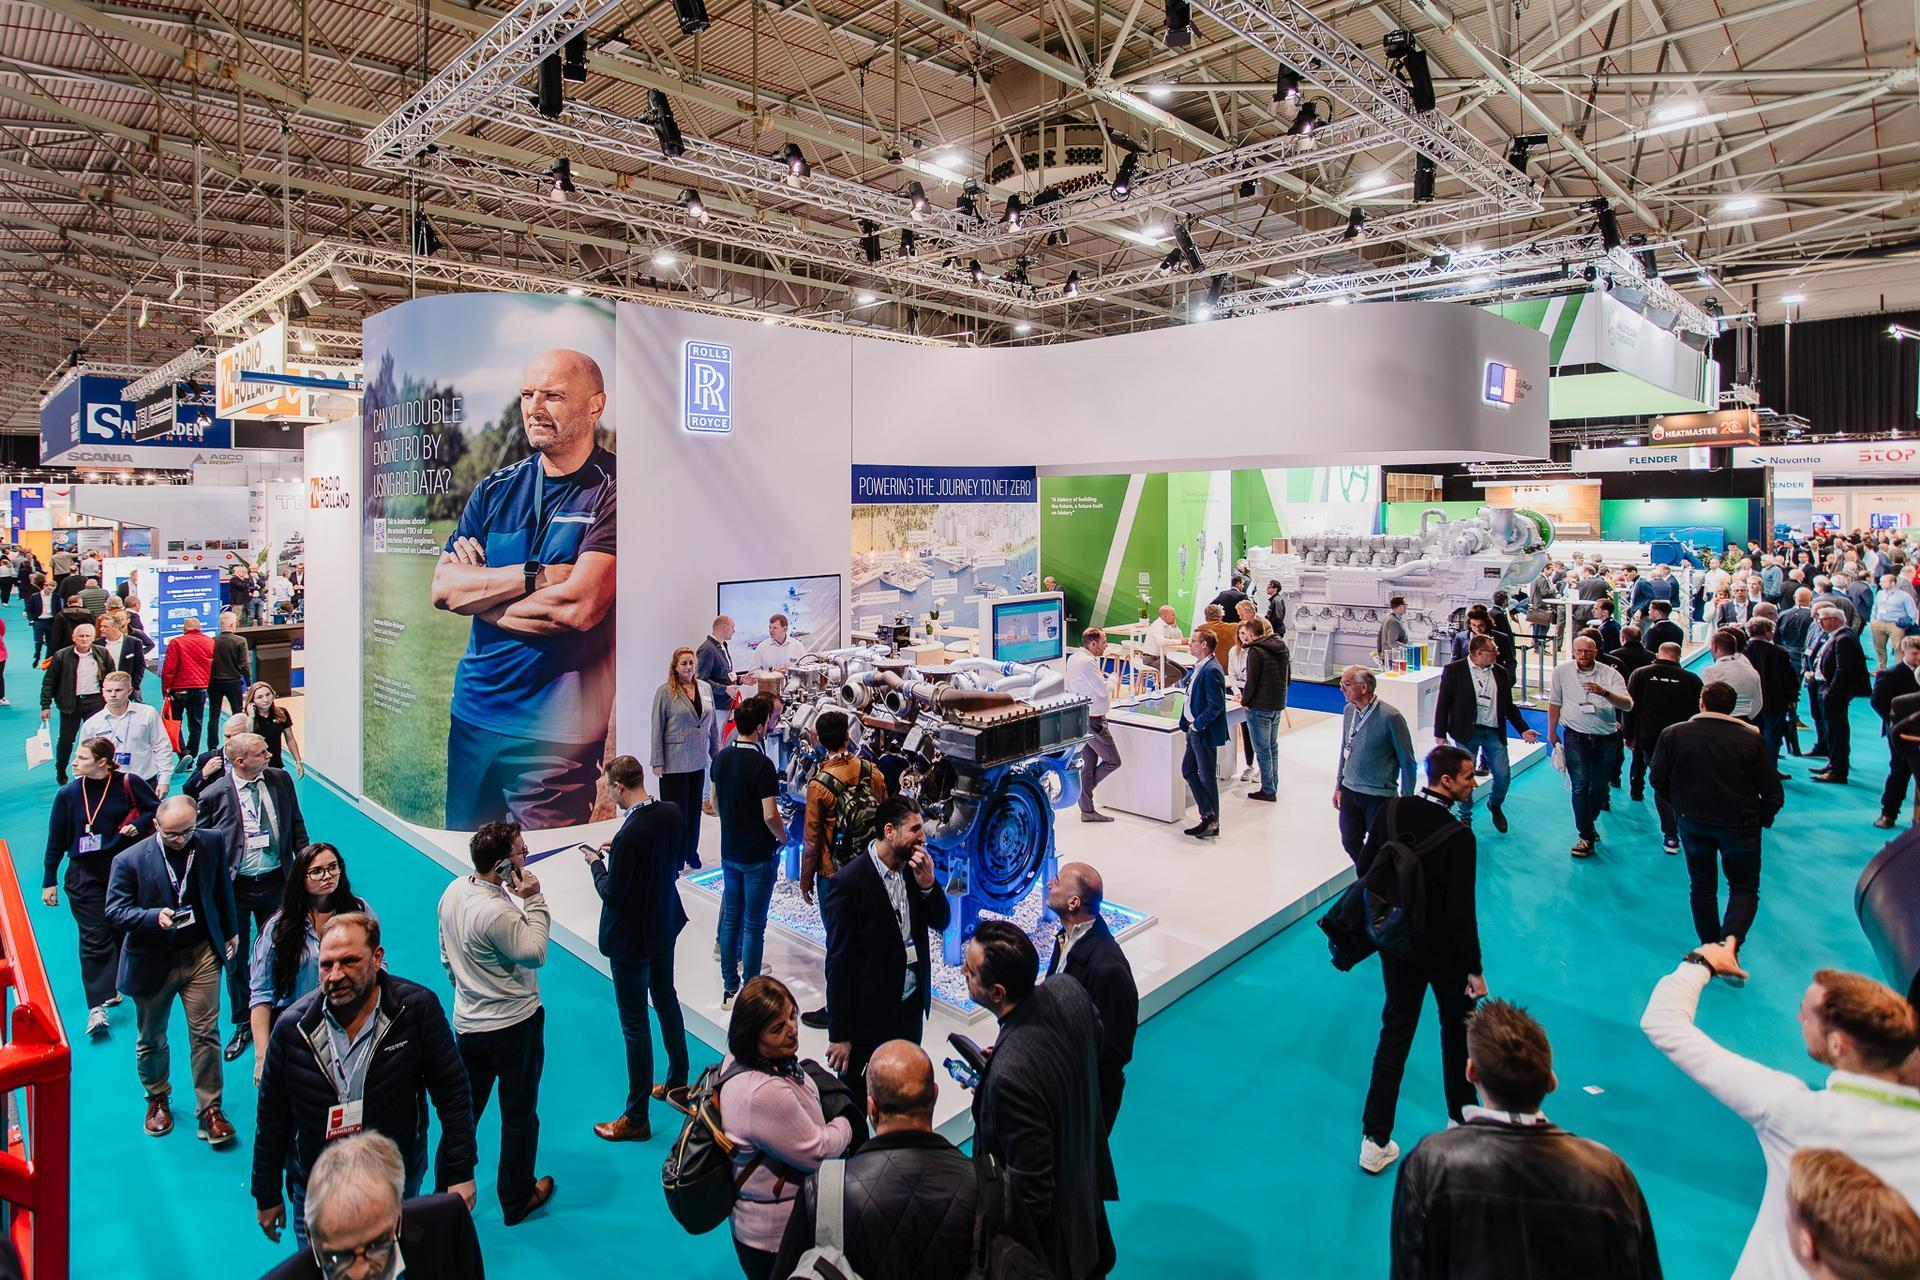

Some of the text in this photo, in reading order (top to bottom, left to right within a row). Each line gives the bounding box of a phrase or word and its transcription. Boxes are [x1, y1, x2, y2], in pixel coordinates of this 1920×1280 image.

[234, 340, 261, 370] RADIO
[692, 346, 728, 359] ROLLS
[373, 397, 463, 433] CAN YOU DOUBLE
[692, 416, 728, 428] ROYCE
[1665, 427, 1718, 438] HEATMASTER
[373, 434, 442, 466] ENGINE TBO BY
[67, 452, 133, 463] SCANIA
[1629, 455, 1678, 464] FLENDER
[1770, 456, 1821, 464] Navantia
[321, 476, 340, 491] RADIO
[373, 468, 451, 498] USING BIG DATA?
[859, 476, 1031, 496] POWERING THE JOURNEY TO NET ZERO
[21, 489, 41, 498] NL
[321, 492, 351, 509] HOLLAND
[414, 537, 436, 545] engines.
